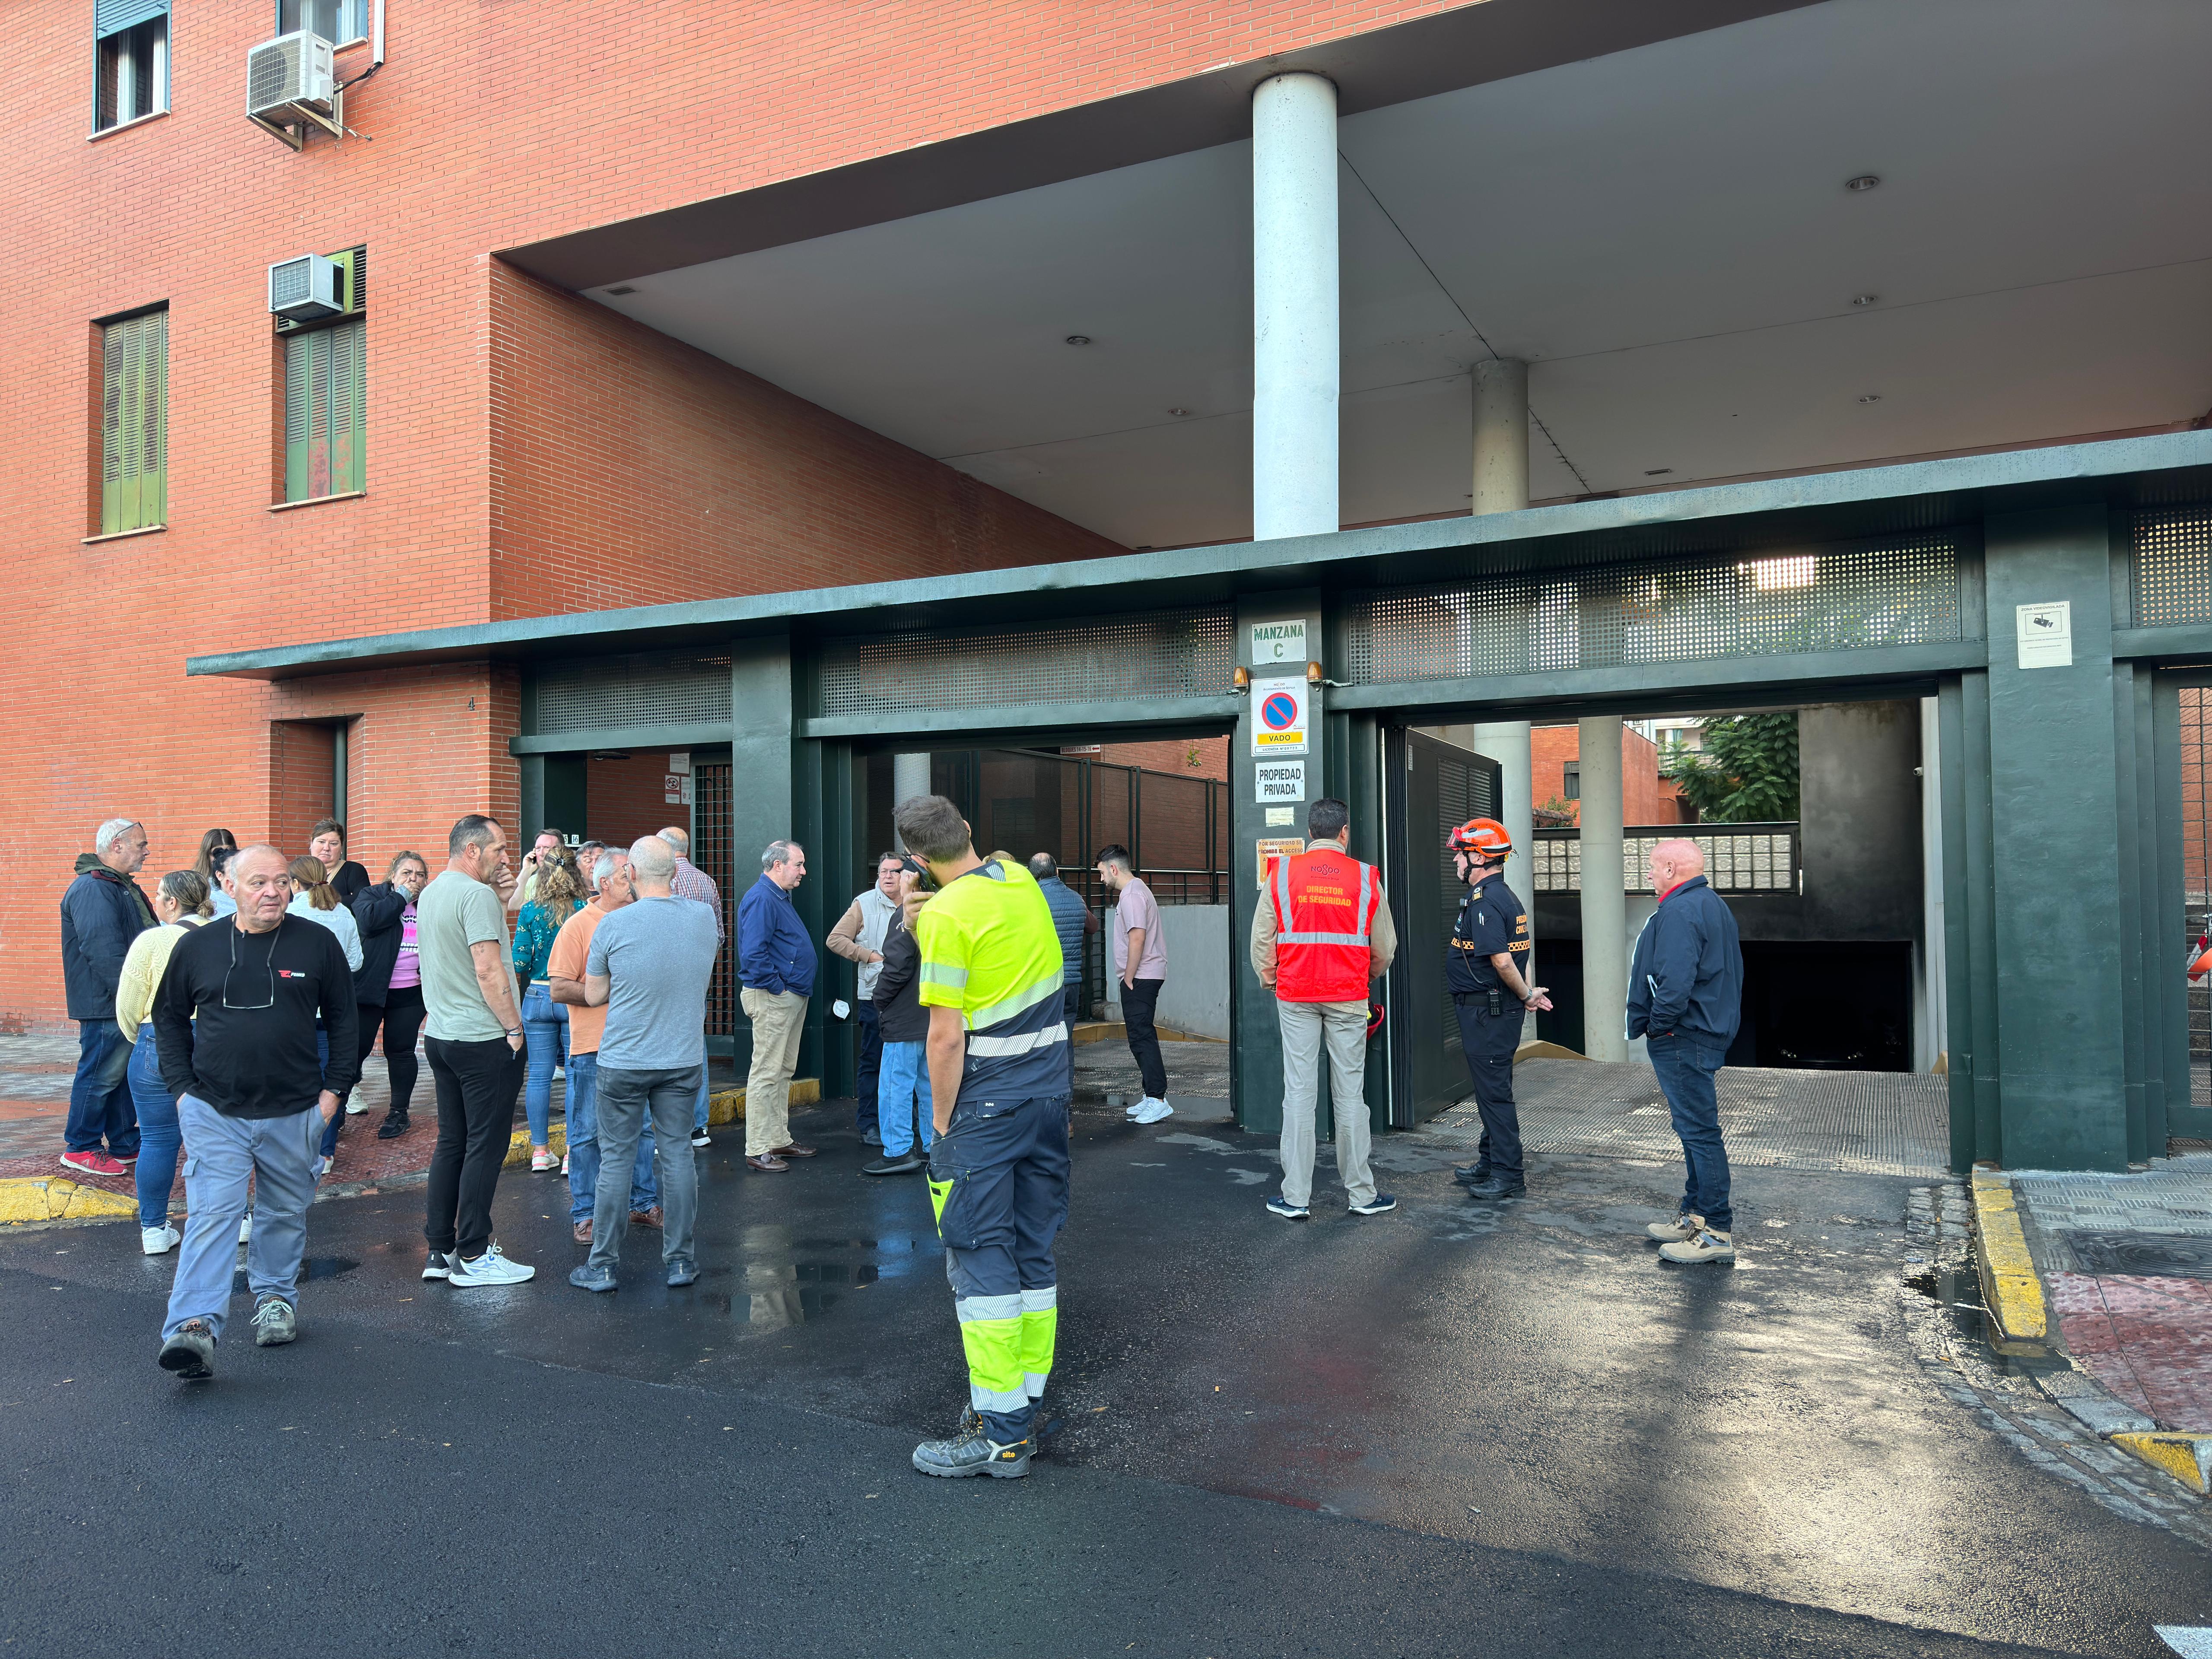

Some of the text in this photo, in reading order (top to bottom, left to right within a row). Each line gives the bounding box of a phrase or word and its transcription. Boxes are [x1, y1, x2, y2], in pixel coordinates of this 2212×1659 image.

[1254, 625, 1303, 641] MANZANA
[1274, 643, 1283, 658] C
[1259, 768, 1301, 781] PROPIEDAD
[1264, 783, 1297, 795] PRIVADA
[1306, 886, 1343, 895] DIRECTOR
[1309, 896, 1351, 906] SEGURIDAD
